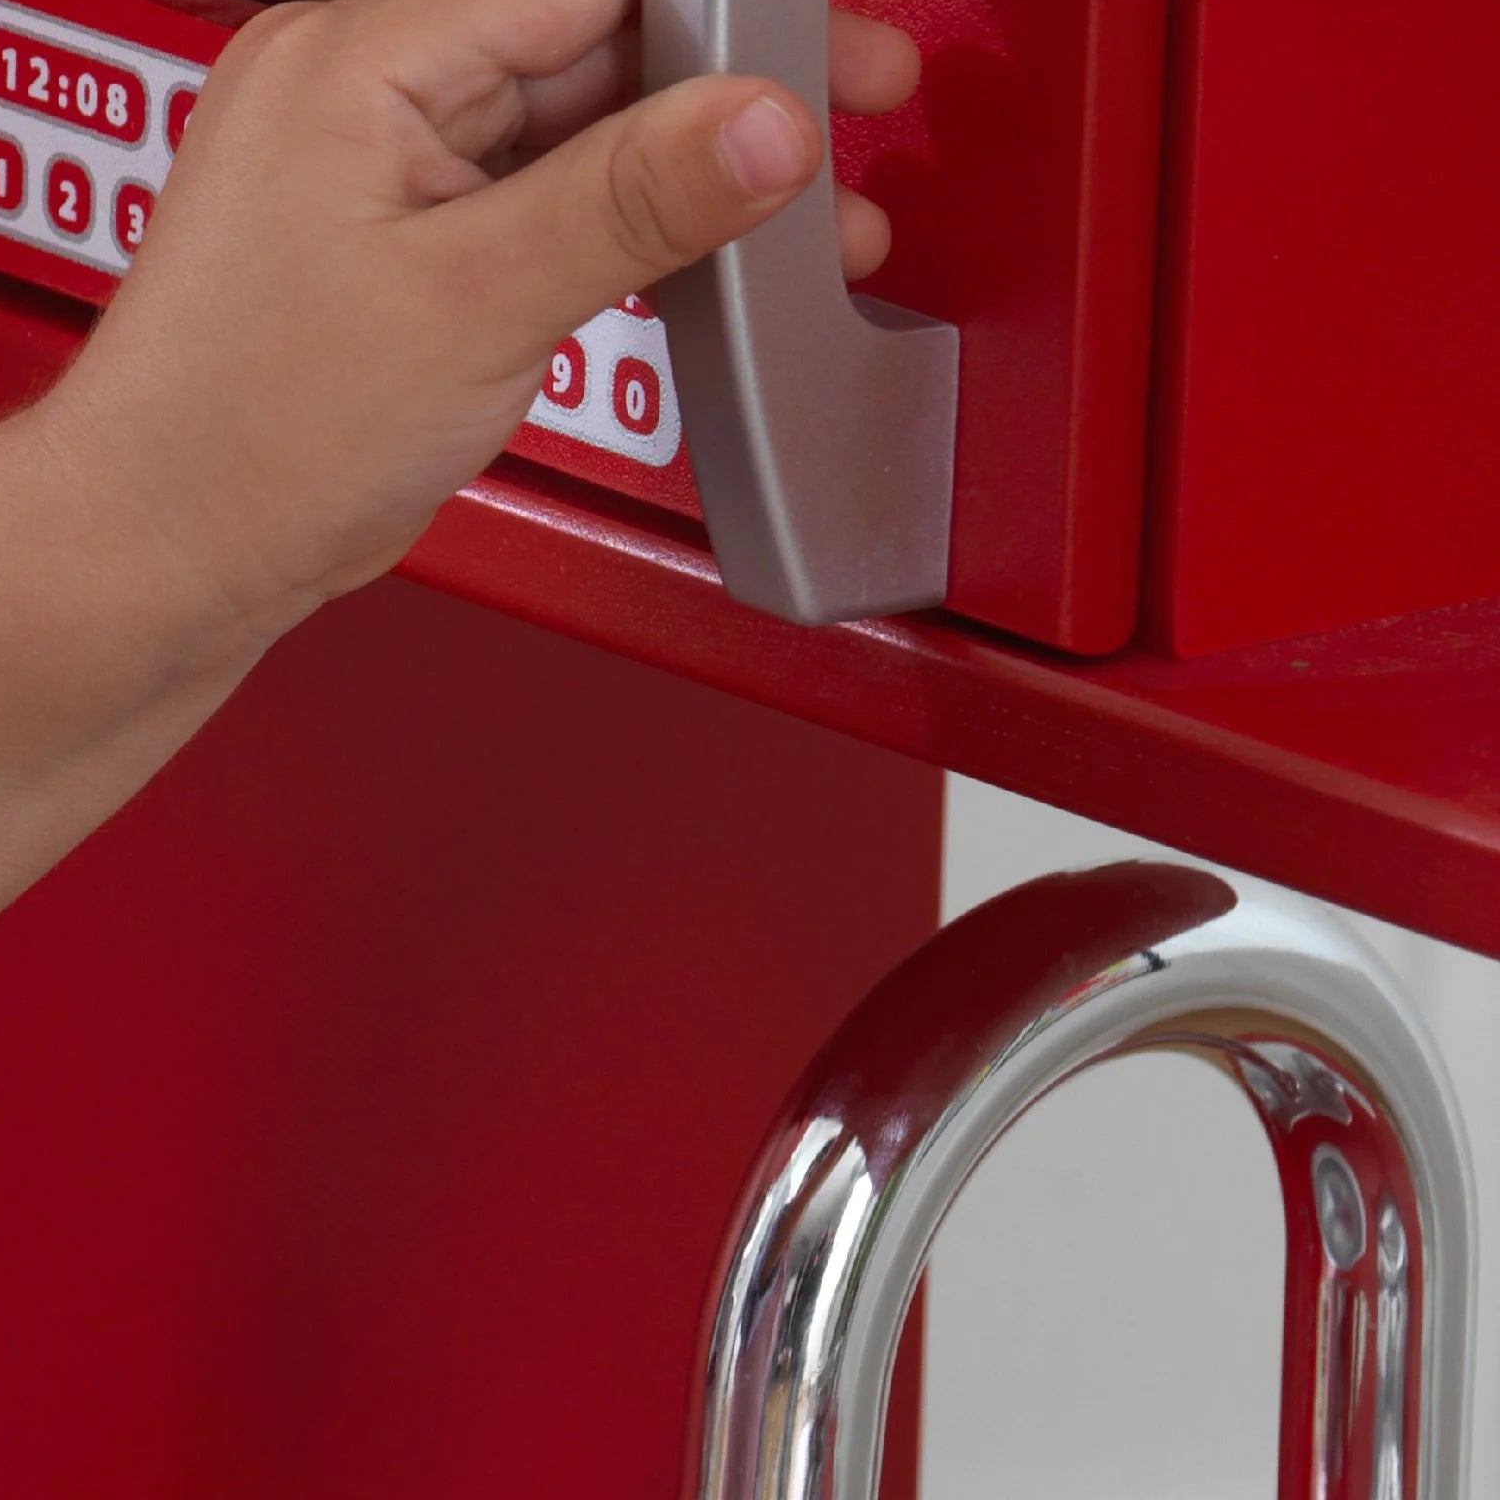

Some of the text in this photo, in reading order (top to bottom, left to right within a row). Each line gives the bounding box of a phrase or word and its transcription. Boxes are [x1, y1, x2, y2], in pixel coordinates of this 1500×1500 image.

[2, 47, 128, 128] 12:08
[58, 180, 77, 222] 2
[127, 203, 145, 245] 3
[552, 352, 573, 394] 9
[625, 379, 646, 421] 0
